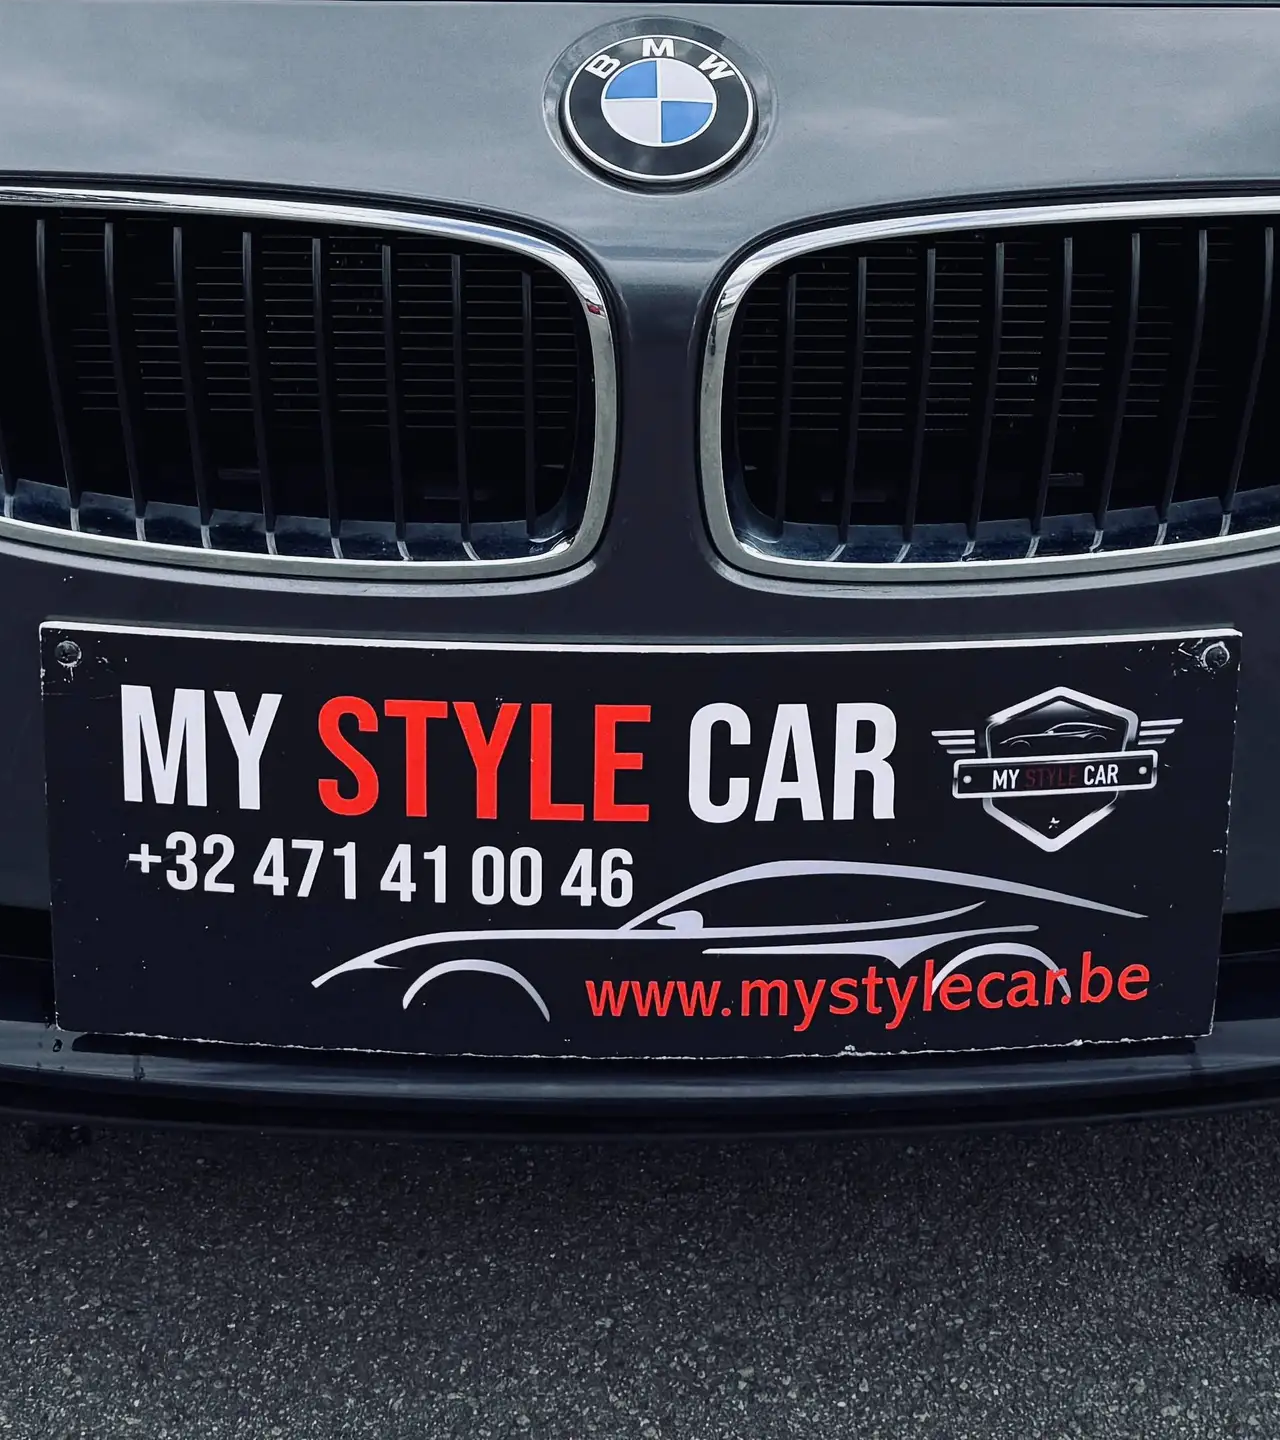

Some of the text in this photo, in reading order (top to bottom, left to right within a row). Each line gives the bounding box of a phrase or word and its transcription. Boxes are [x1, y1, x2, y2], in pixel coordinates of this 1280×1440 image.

[584, 38, 737, 81] BMW
[120, 684, 897, 824] MY STYLE CAR
[992, 763, 1119, 790] MY STYLE CAR
[128, 831, 634, 907] +32 471 41 00 46
[585, 950, 1151, 1032] www.mystylecar.be
